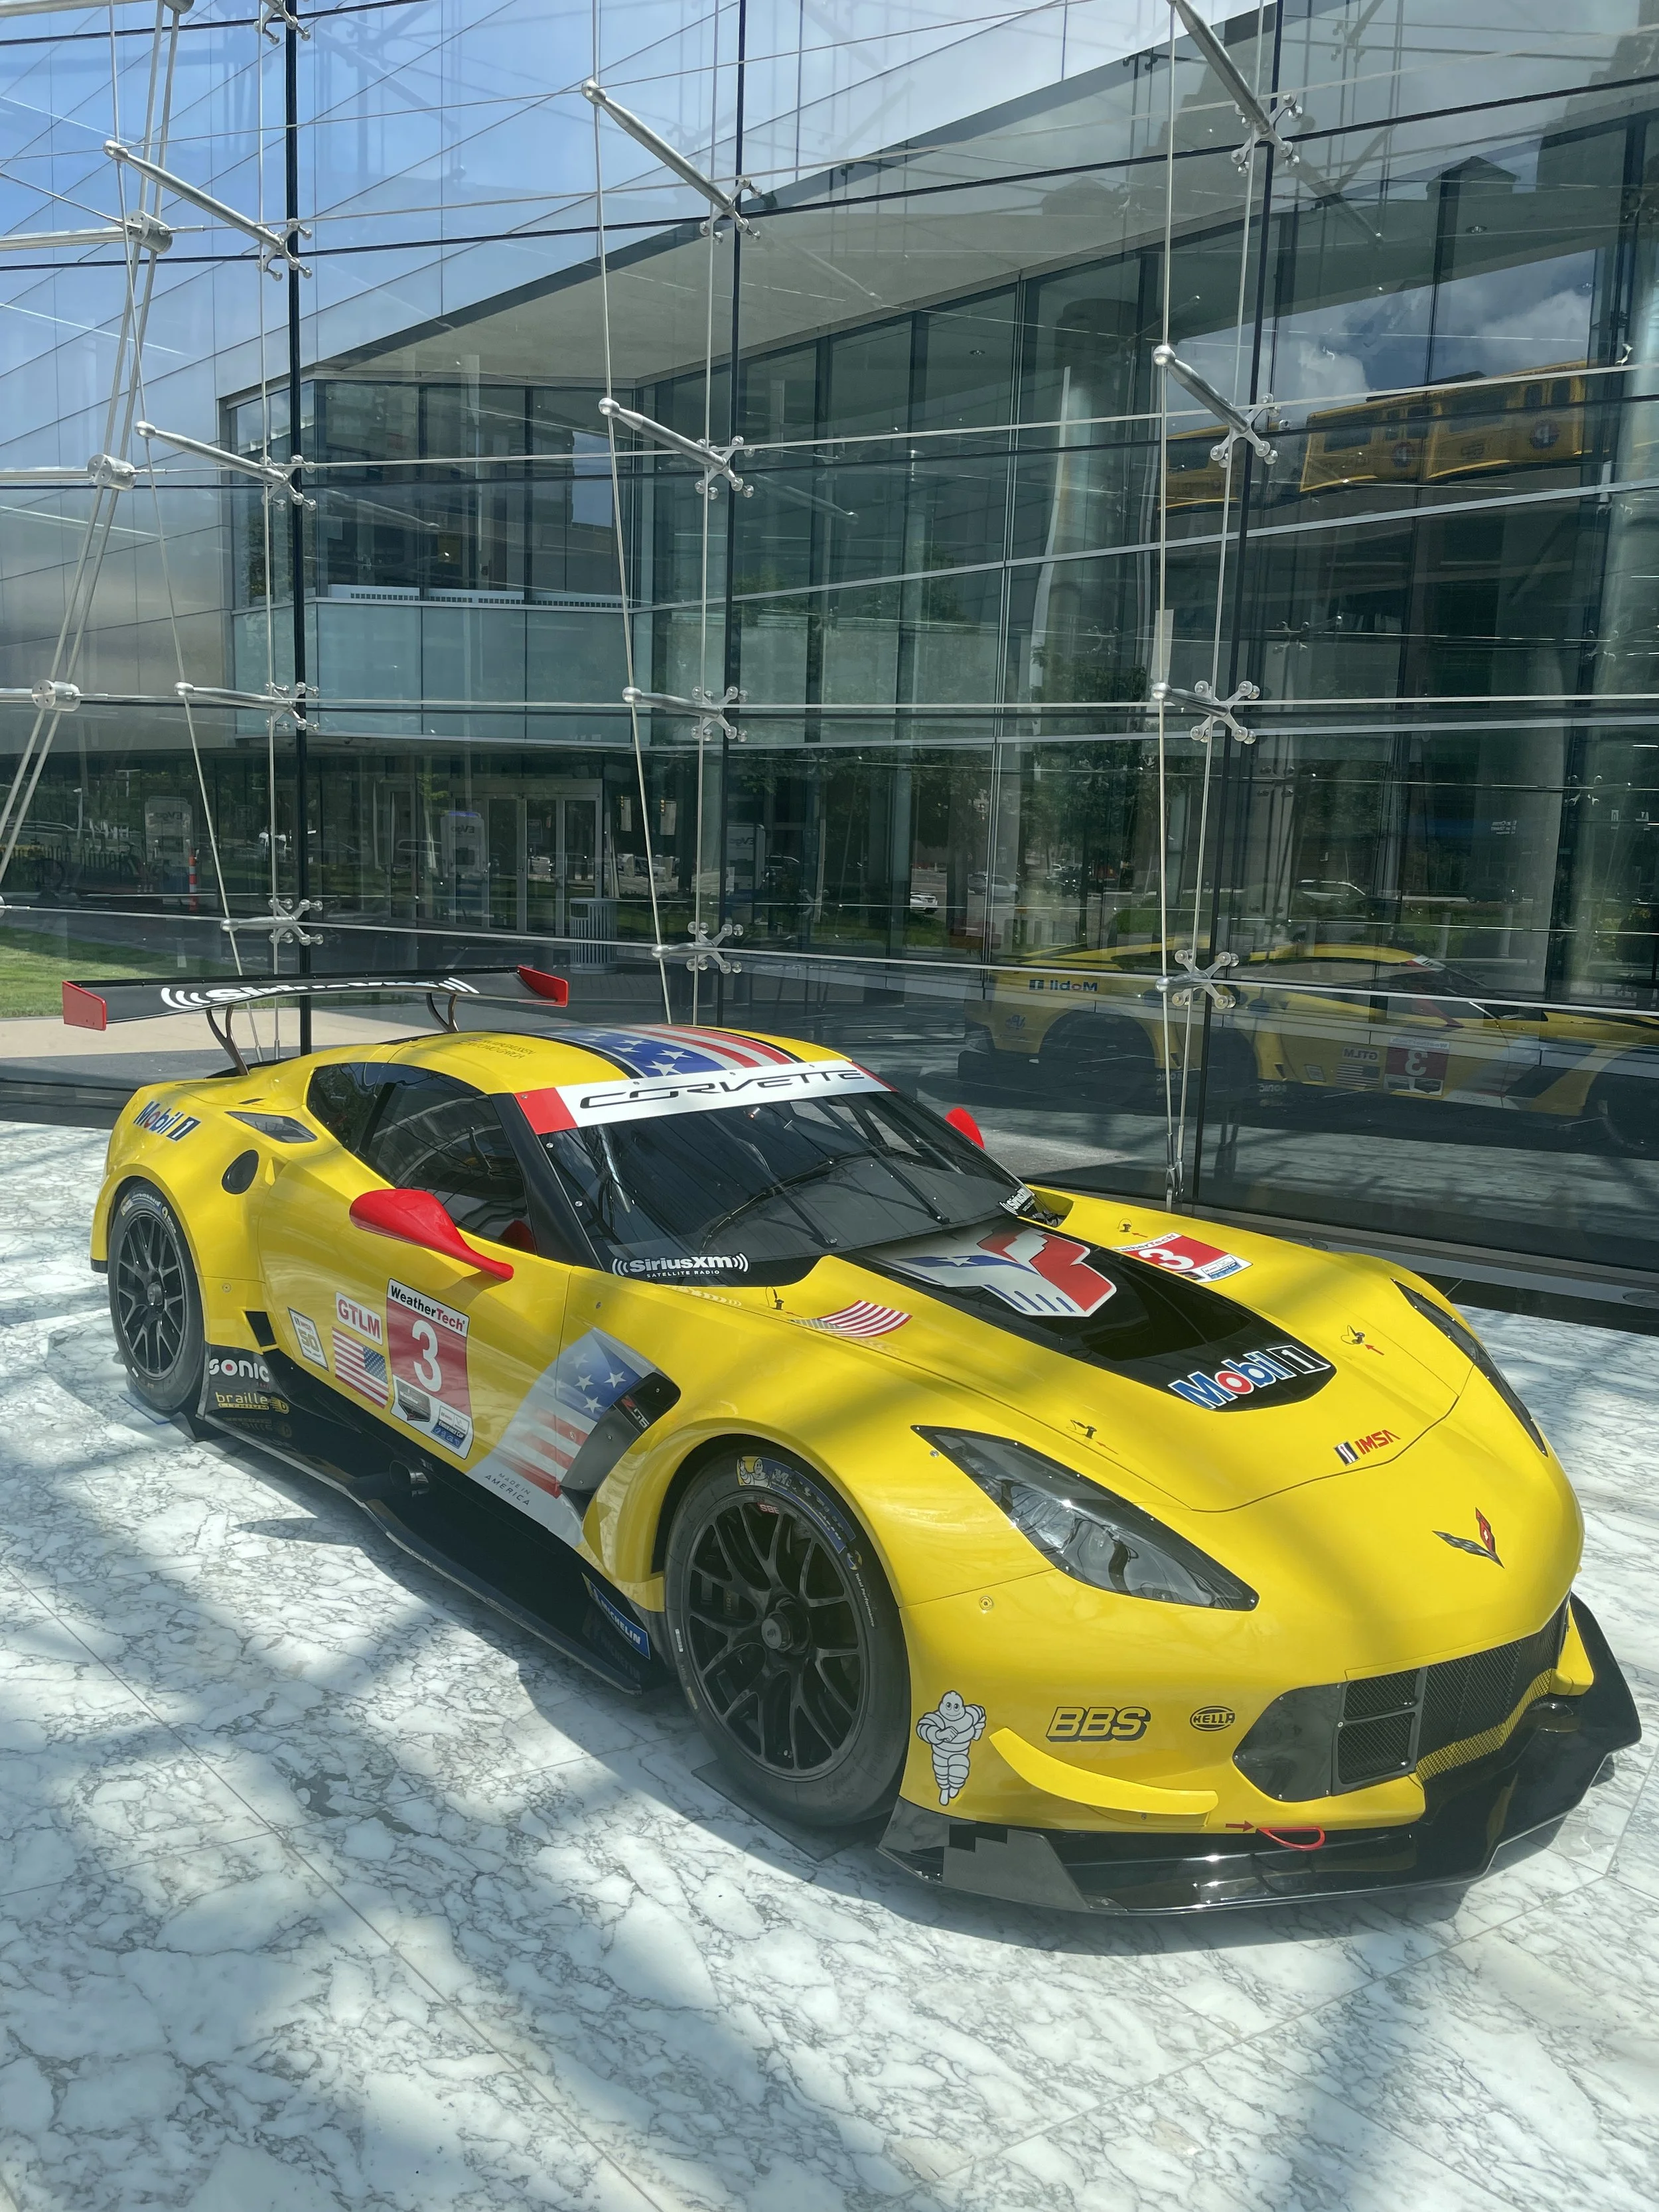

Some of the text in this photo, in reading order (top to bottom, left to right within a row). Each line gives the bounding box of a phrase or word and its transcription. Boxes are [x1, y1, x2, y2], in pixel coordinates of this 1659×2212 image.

[580, 1070, 864, 1109] CORVETTE
[133, 1100, 185, 1136] Mobil
[1138, 1248, 1195, 1270] 3
[337, 1299, 381, 1339] GTLM
[390, 1285, 464, 1332] WeatherTech
[298, 1329, 320, 1353] 50
[412, 1319, 442, 1392] 3
[215, 1391, 269, 1405] braille
[1168, 1351, 1297, 1410] Mobil
[1354, 1429, 1402, 1455] IMSA
[484, 1475, 530, 1506] AMERICA
[498, 1473, 521, 1488] MADE
[855, 1572, 875, 1628] Total Performance
[600, 1599, 641, 1645] MICHELIN
[1046, 1706, 1151, 1742] BBS
[1192, 1711, 1236, 1726] HELLA
